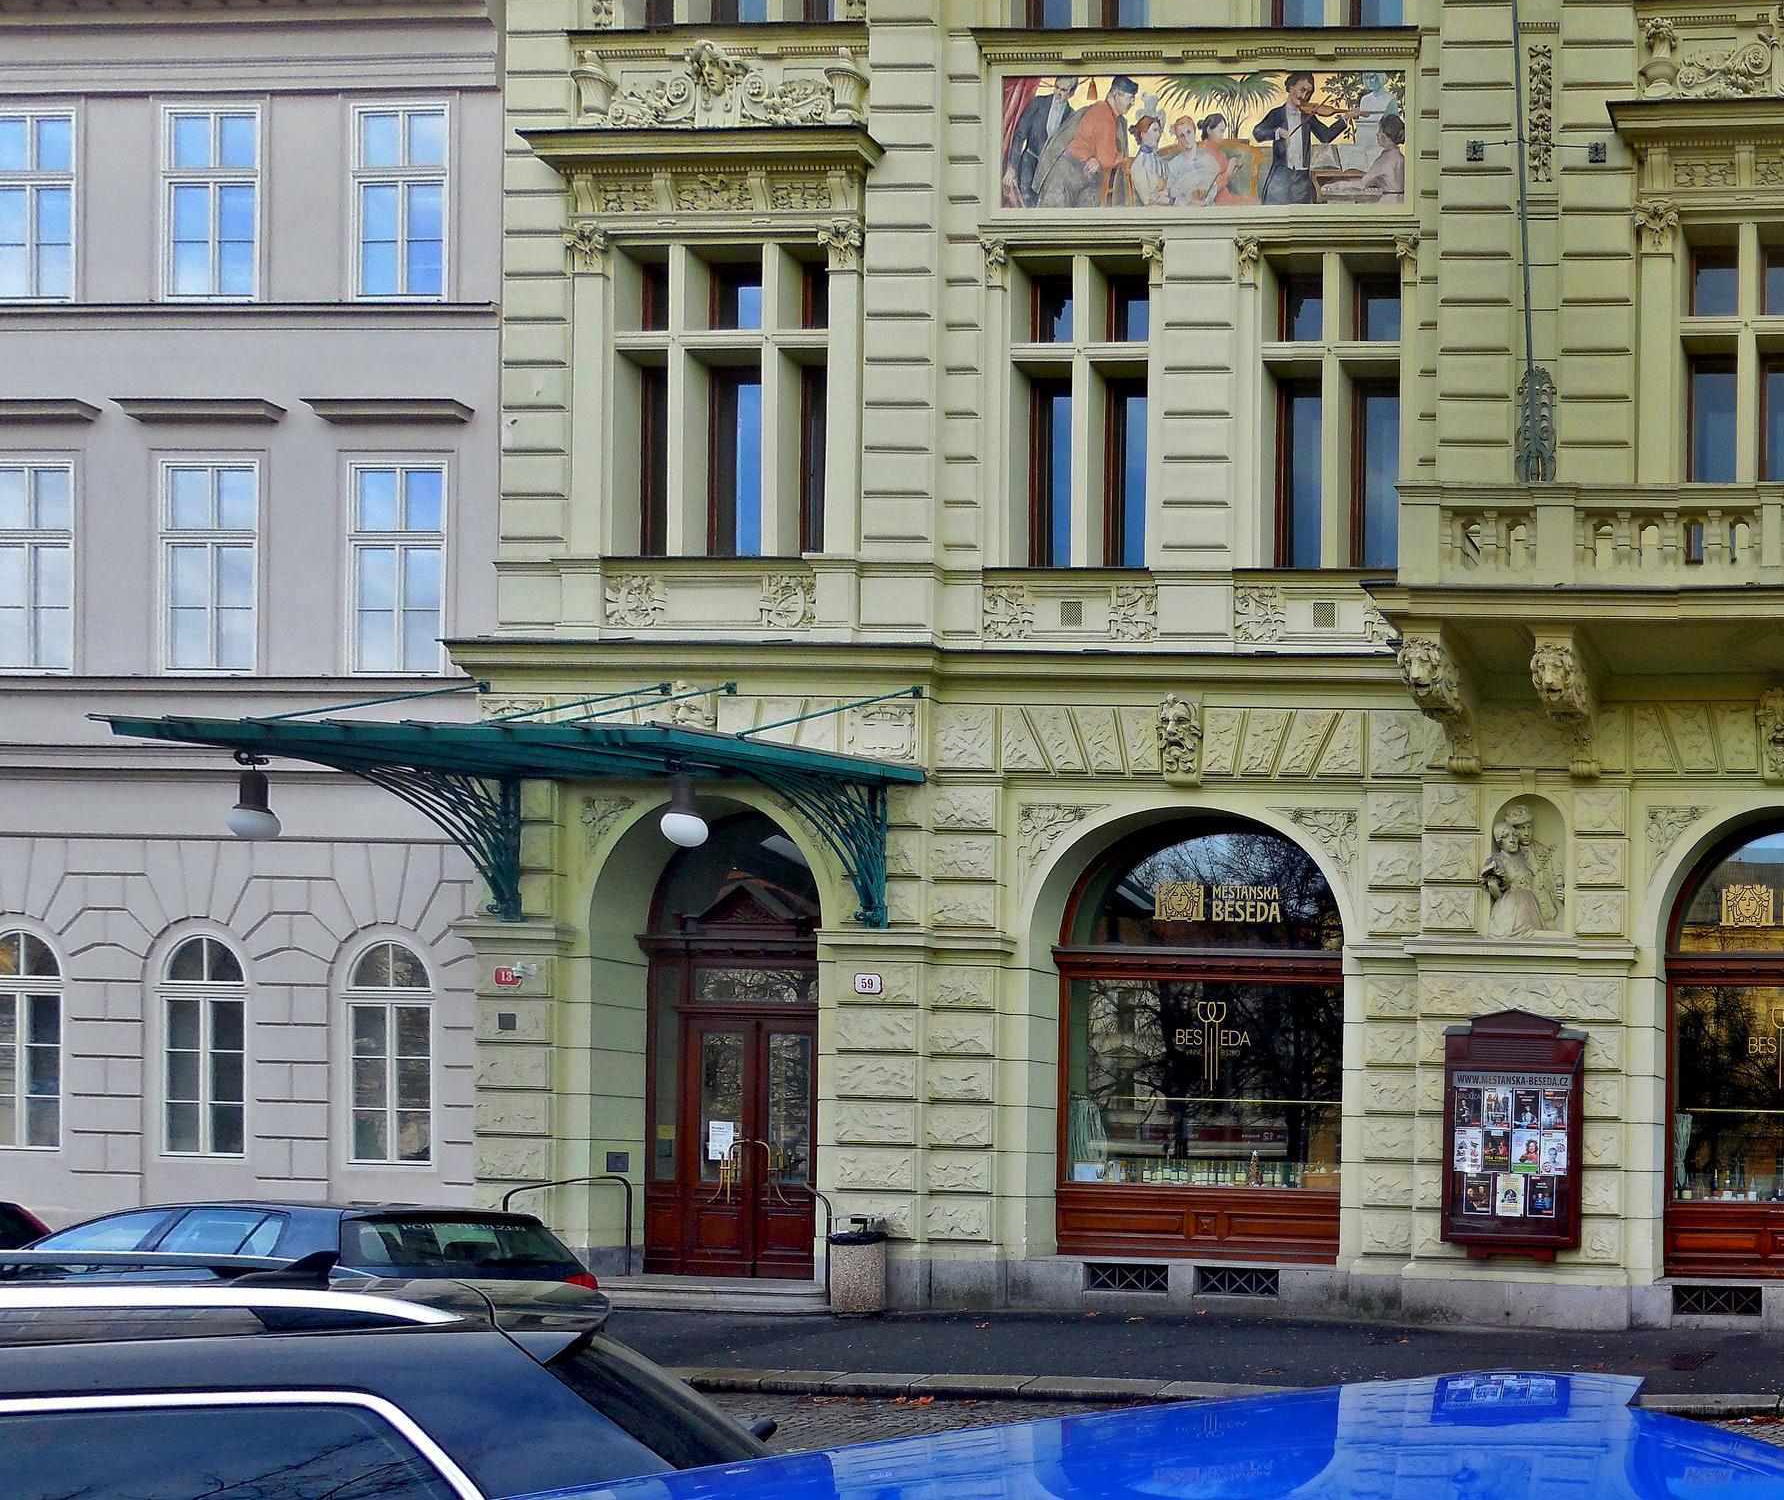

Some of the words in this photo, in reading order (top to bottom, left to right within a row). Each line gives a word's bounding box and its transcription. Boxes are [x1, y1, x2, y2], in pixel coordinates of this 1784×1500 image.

[1212, 901, 1281, 922] BESEDA
[501, 971, 512, 982] 13
[861, 978, 873, 989] 59
[1457, 1074, 1569, 1086] WWW.MESTANSKA-BESEDA.CZ
